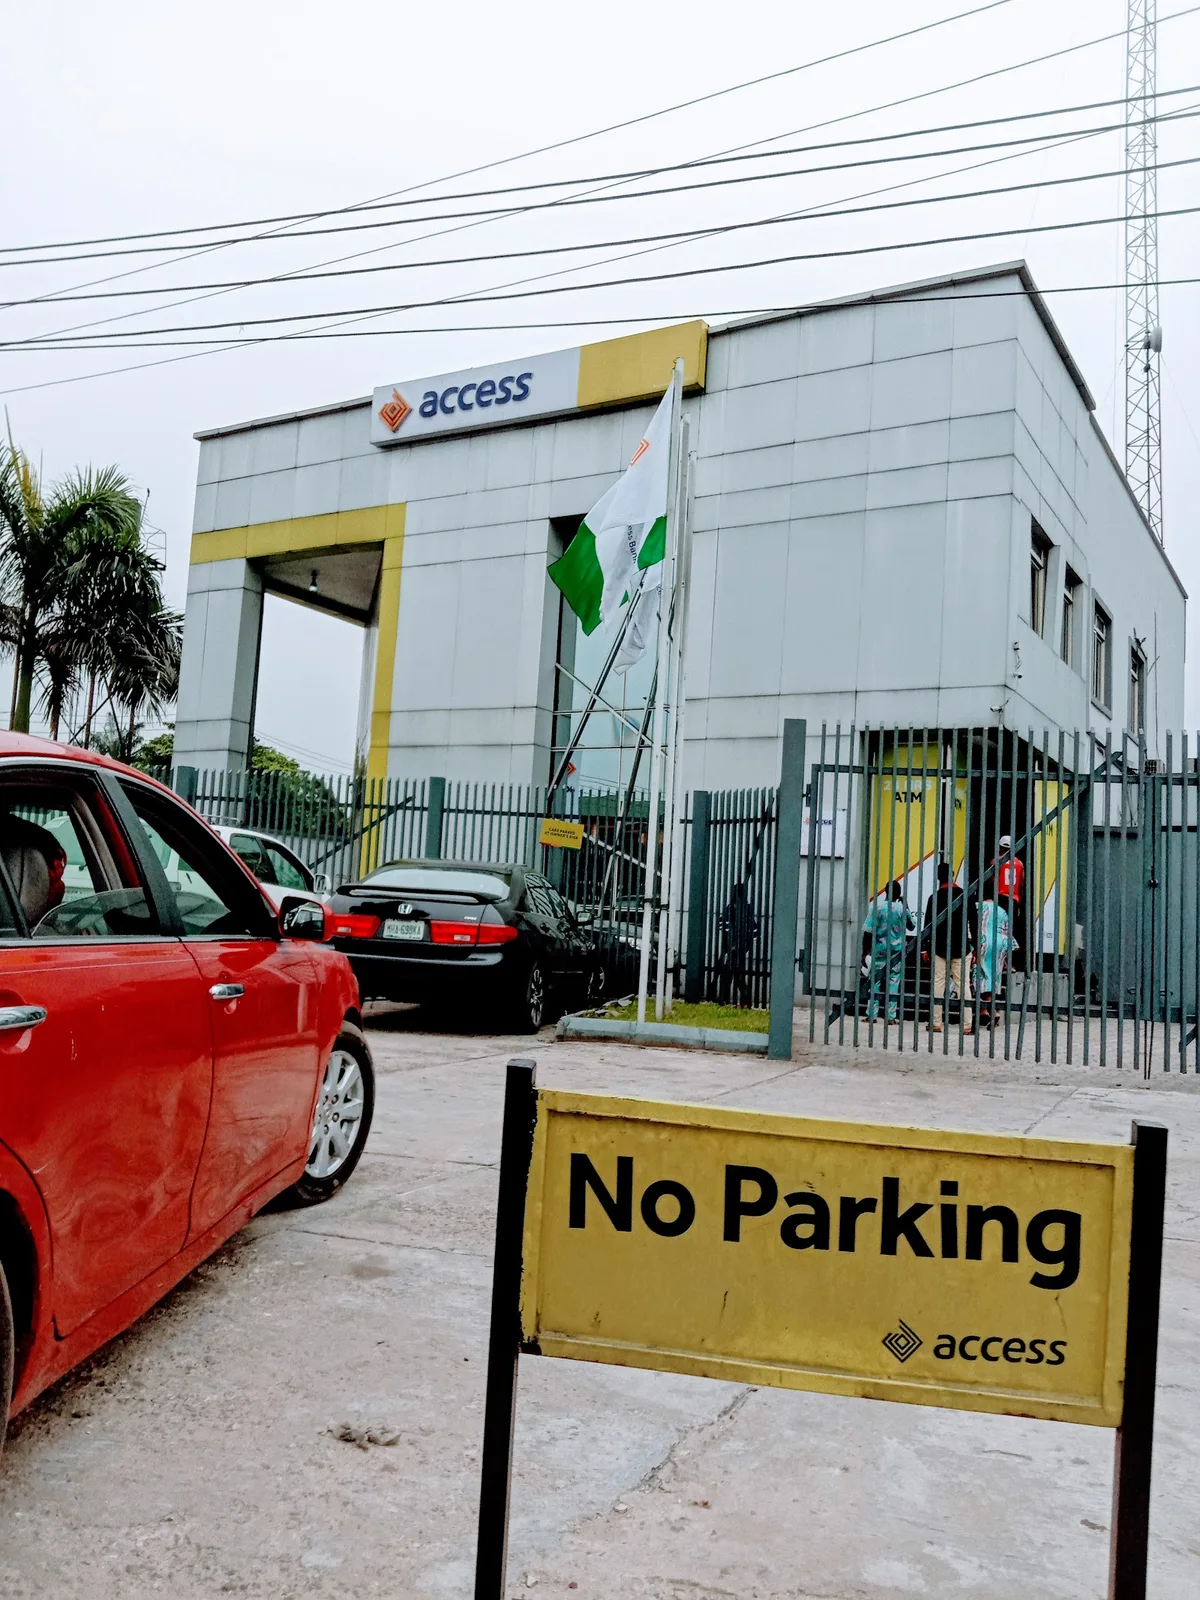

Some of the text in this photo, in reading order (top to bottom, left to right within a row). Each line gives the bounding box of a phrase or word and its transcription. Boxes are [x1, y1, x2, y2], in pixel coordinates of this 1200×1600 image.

[419, 372, 533, 418] access
[895, 791, 922, 803] ATM
[568, 1152, 1082, 1291] No Parking
[932, 1334, 1068, 1366] access
